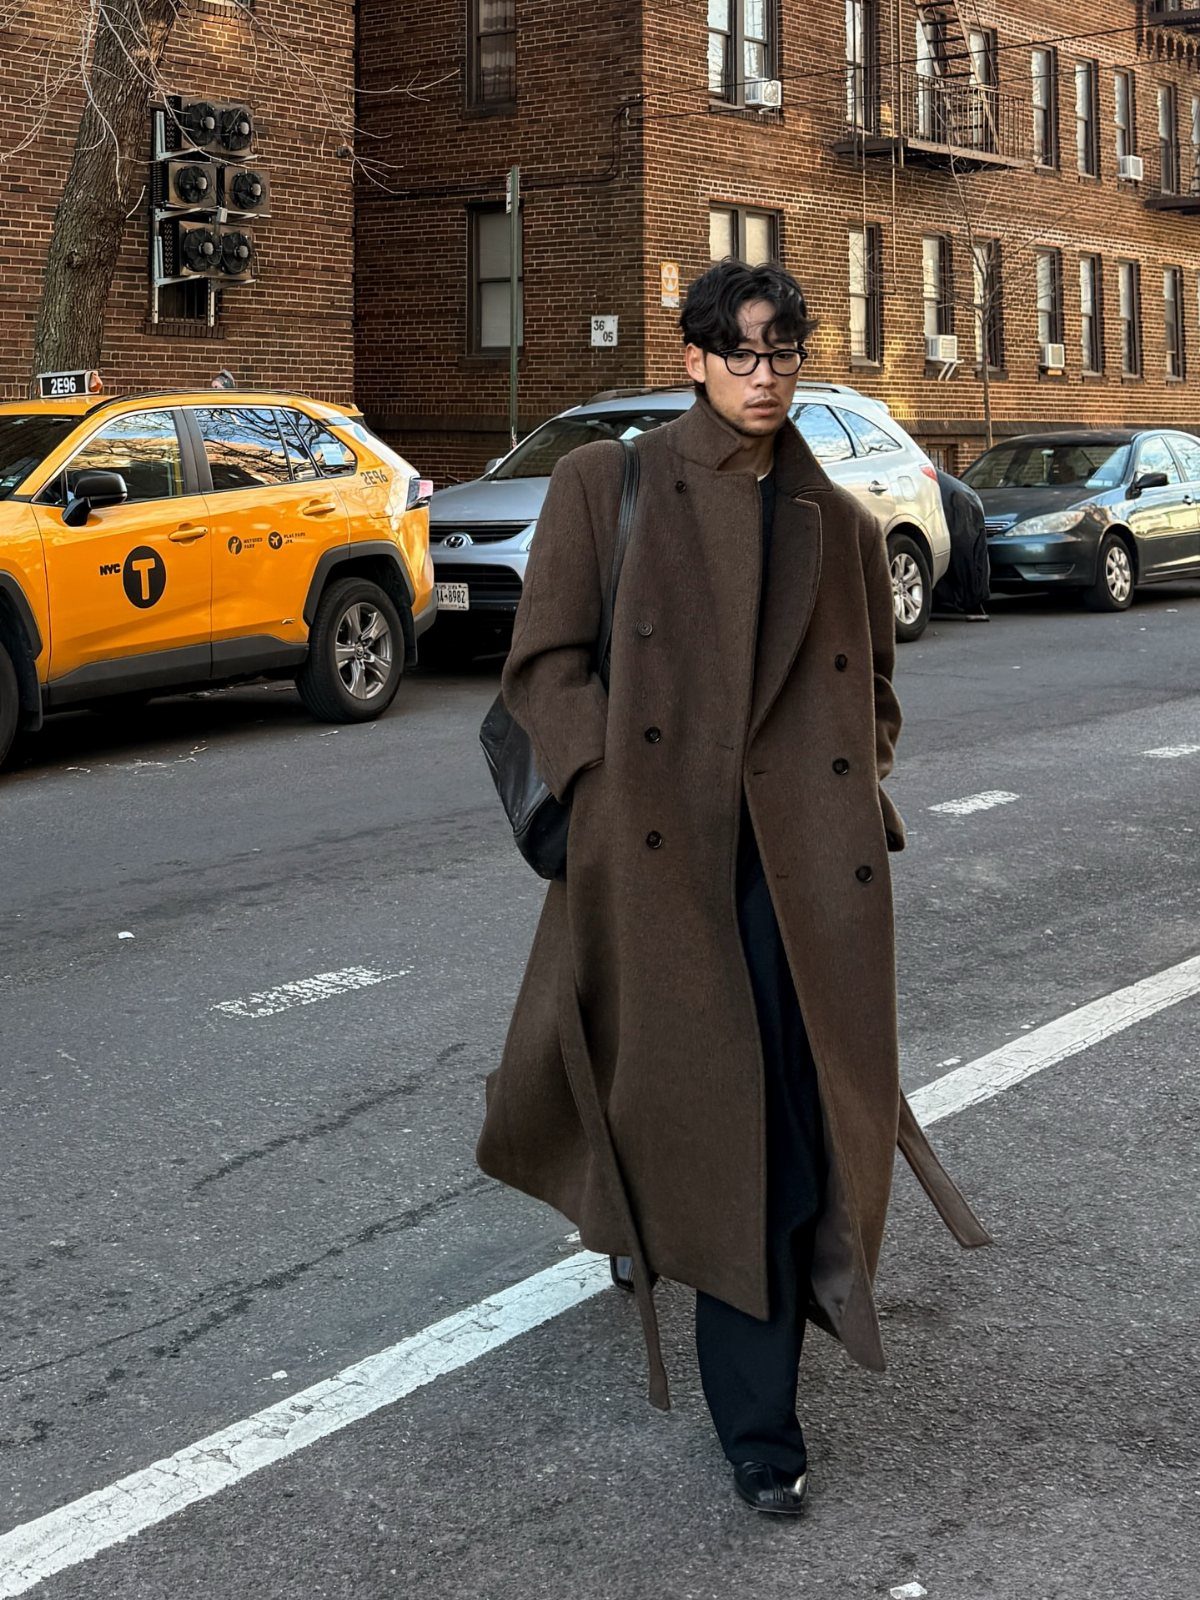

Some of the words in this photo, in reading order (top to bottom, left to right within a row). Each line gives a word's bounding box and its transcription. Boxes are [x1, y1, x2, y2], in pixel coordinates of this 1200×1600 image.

[593, 320, 605, 331] 36
[602, 331, 614, 342] 05
[50, 377, 77, 394] 2E96
[360, 469, 389, 485] 2E96
[99, 563, 121, 576] NYC
[131, 557, 156, 600] T
